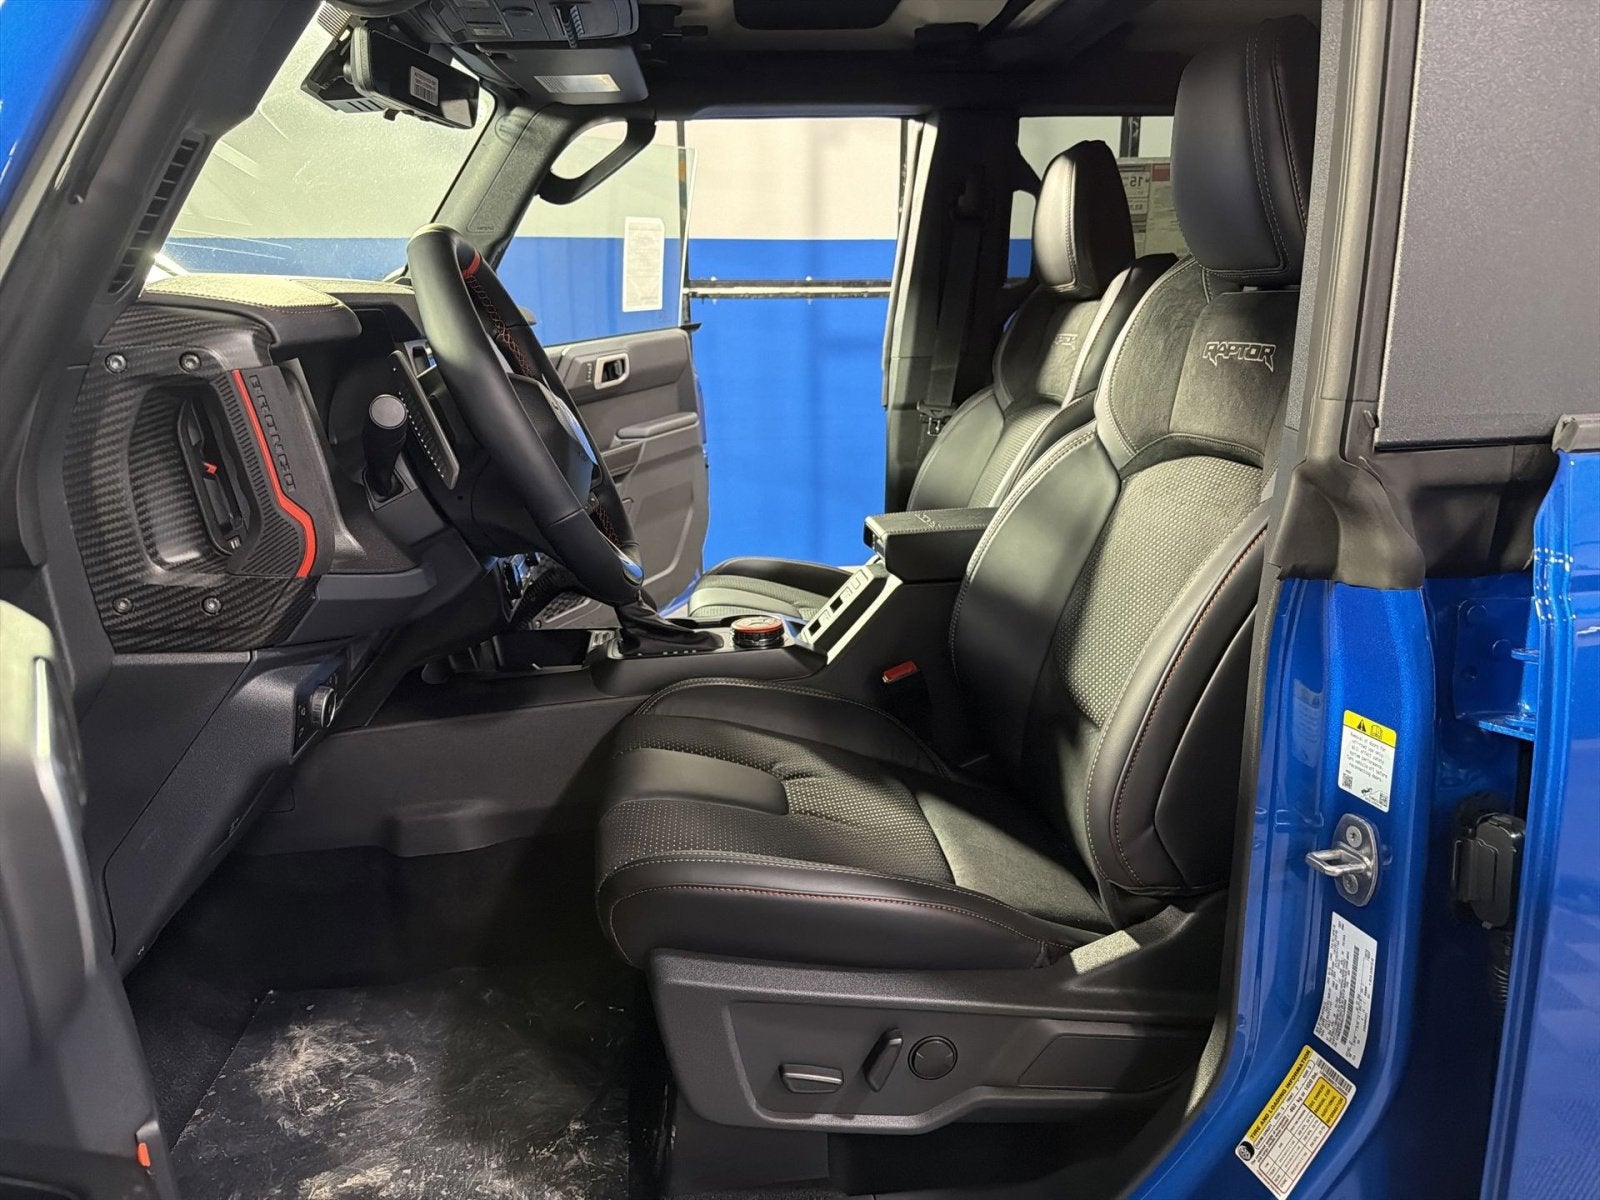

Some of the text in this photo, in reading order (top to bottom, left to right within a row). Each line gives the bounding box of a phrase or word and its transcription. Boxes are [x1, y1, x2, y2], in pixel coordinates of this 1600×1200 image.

[1202, 341, 1277, 373] RAPTOR
[249, 374, 297, 492] BRONCO
[1249, 1125, 1261, 1140] TIRE
[1259, 1111, 1270, 1126] AND
[1267, 1087, 1287, 1114] LOADING
[1284, 1048, 1311, 1089] INFORMATION
